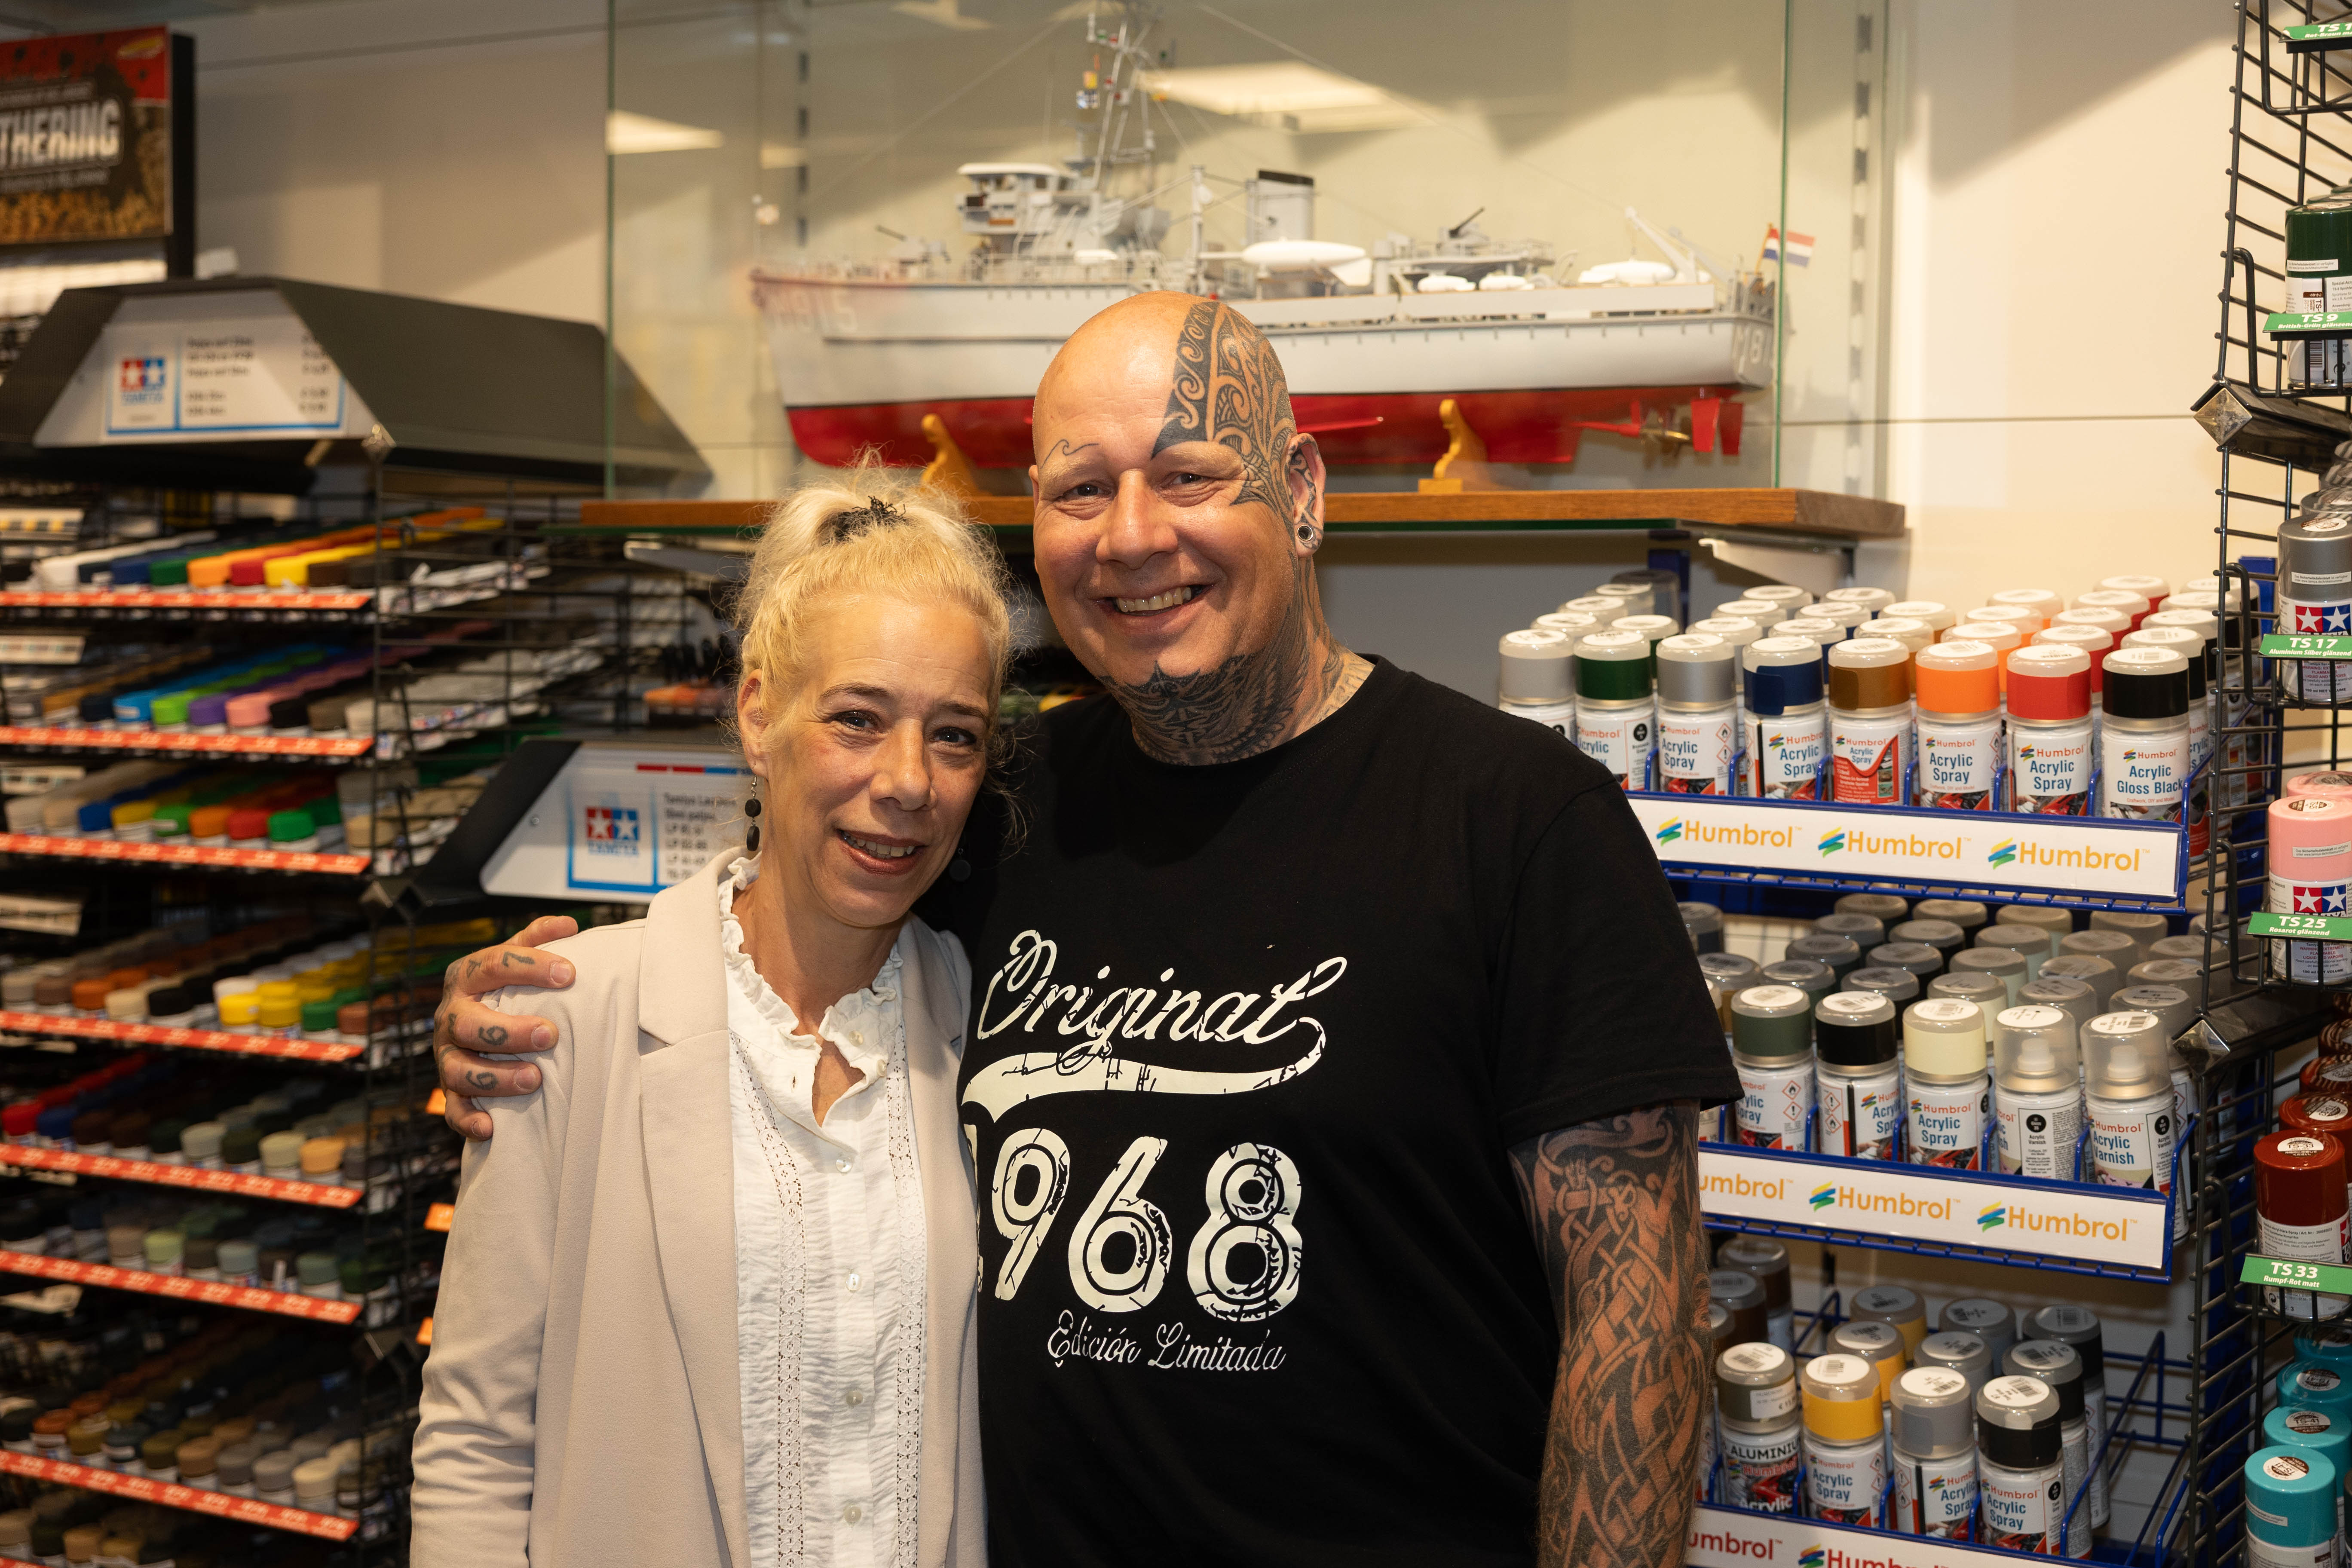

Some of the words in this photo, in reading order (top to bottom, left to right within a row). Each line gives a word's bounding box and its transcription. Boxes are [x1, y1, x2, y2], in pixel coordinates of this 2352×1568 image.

[2318, 23, 2340, 32] TS
[2301, 313, 2324, 322] TS
[2326, 313, 2338, 322] 9
[2290, 637, 2312, 648] TS
[2316, 638, 2338, 649] 17
[1662, 738, 1697, 755] Acrylic
[1780, 744, 1819, 763] Acrylic
[1850, 747, 1873, 756] Acrylic
[1664, 753, 1695, 770] Spray
[1852, 756, 1872, 764] Spray
[1930, 752, 1972, 769] Acrylic
[2030, 760, 2074, 776] Acrylic
[1933, 768, 1969, 784] Spray
[2129, 765, 2171, 780] Acrylic
[2034, 776, 2071, 792] Spray
[2117, 780, 2150, 795] Gloss
[2154, 778, 2183, 794] Black
[2279, 916, 2301, 927] TS
[2302, 918, 2327, 928] 25
[1918, 1114, 1960, 1131] Acrylic
[1921, 1130, 1958, 1147] Spray
[2093, 1130, 2130, 1150] Acrylic
[2093, 1144, 2135, 1164] Varnish
[1700, 1173, 1785, 1201] umbrol
[2271, 1262, 2293, 1276] TS
[2295, 1265, 2318, 1279] 33
[2263, 1275, 2301, 1285] Rumpf-Rot
[1047, 1310, 1140, 1367] Edición
[1148, 1323, 1286, 1371] Limitada
[1813, 1468, 1853, 1488] Acrylic
[2273, 1463, 2295, 1476] TS-41
[1816, 1485, 1851, 1502] Spray
[1987, 1494, 2026, 1515] Acrylic
[1990, 1509, 2023, 1531] Spray
[1688, 1531, 1773, 1560] umbrol
